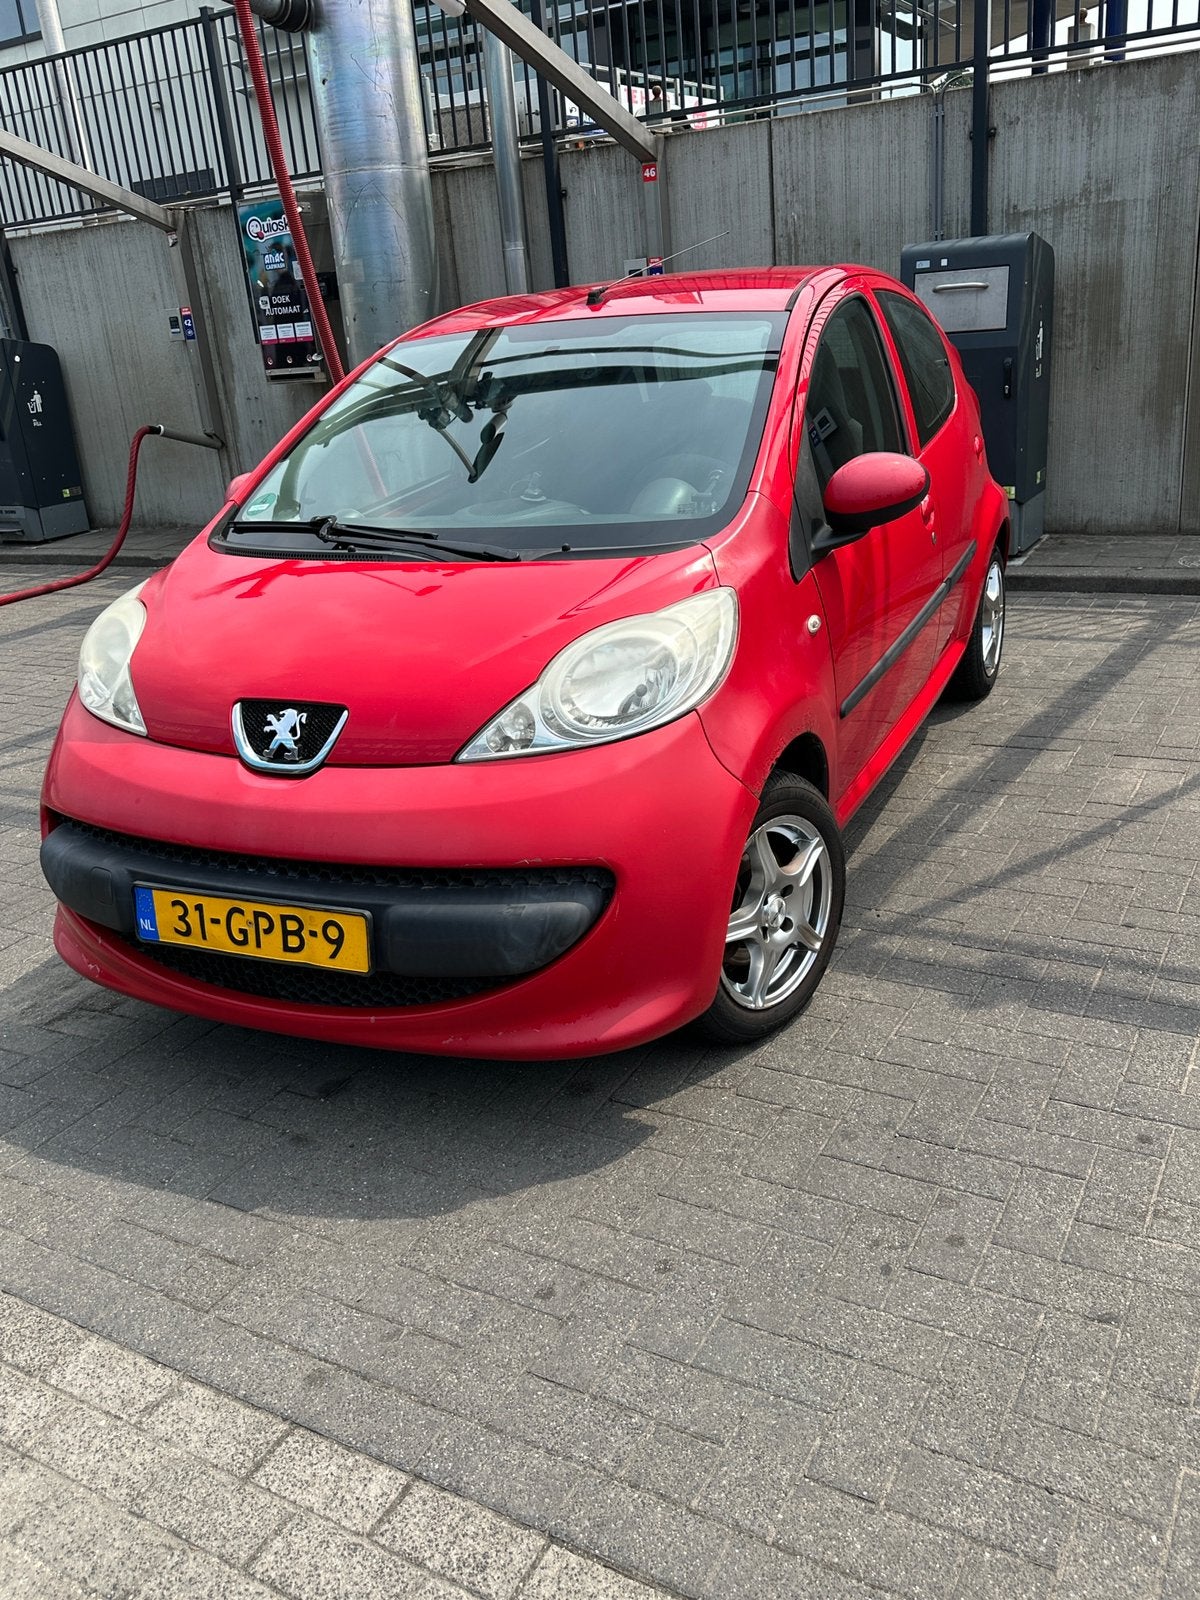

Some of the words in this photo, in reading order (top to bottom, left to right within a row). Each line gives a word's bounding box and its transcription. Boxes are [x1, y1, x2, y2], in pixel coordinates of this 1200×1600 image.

[644, 167, 656, 178] 46
[271, 294, 291, 304] DOEK
[265, 304, 301, 316] AUTOMAAT
[140, 918, 156, 932] NL
[171, 899, 345, 960] 31-GPB-9
